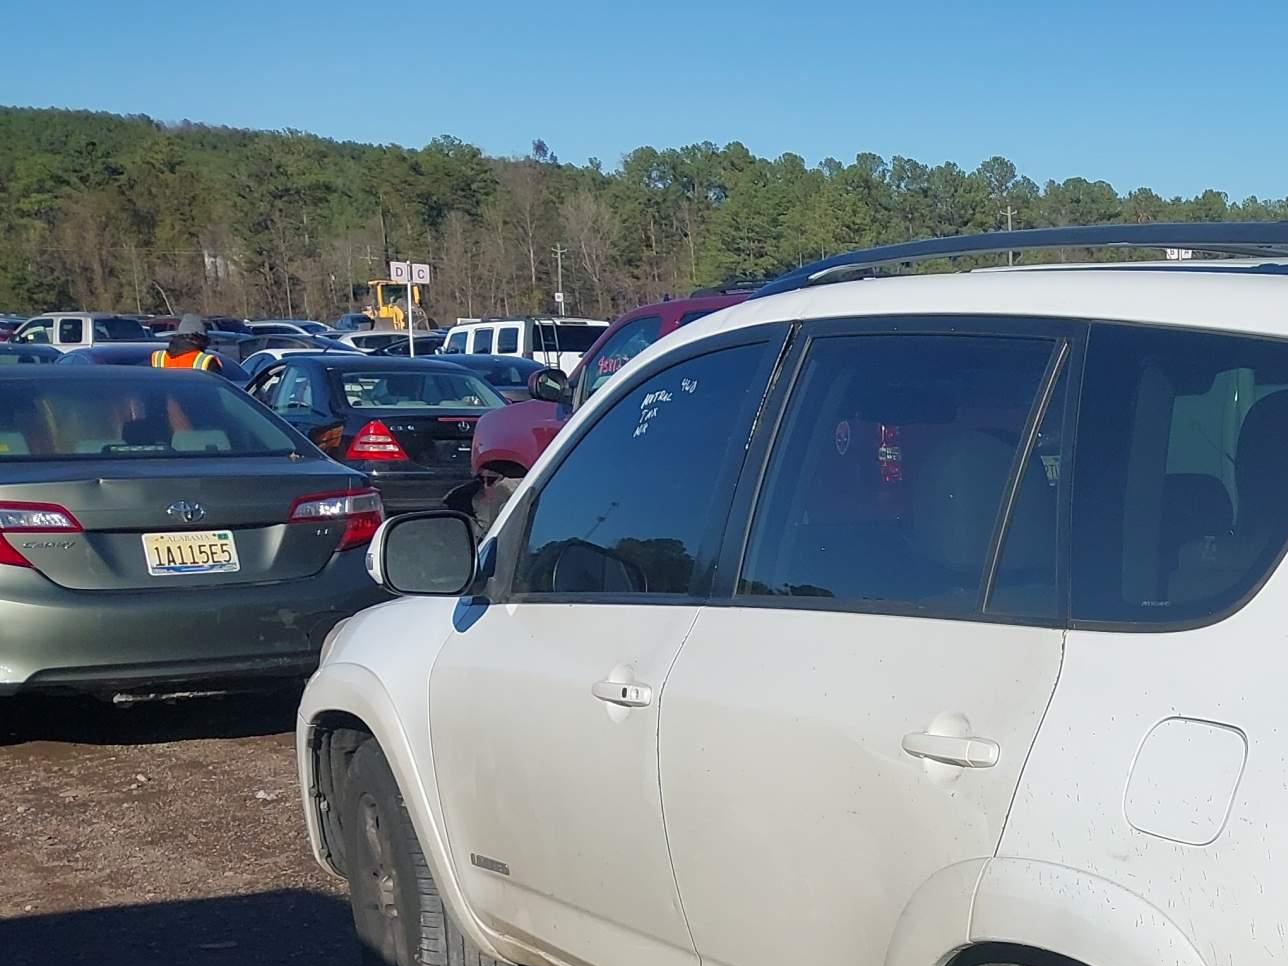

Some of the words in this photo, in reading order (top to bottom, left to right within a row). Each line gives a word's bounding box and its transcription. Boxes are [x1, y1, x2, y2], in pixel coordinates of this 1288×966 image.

[395, 266, 404, 277] D
[417, 269, 425, 280] C
[154, 543, 232, 566] 1A115E5
